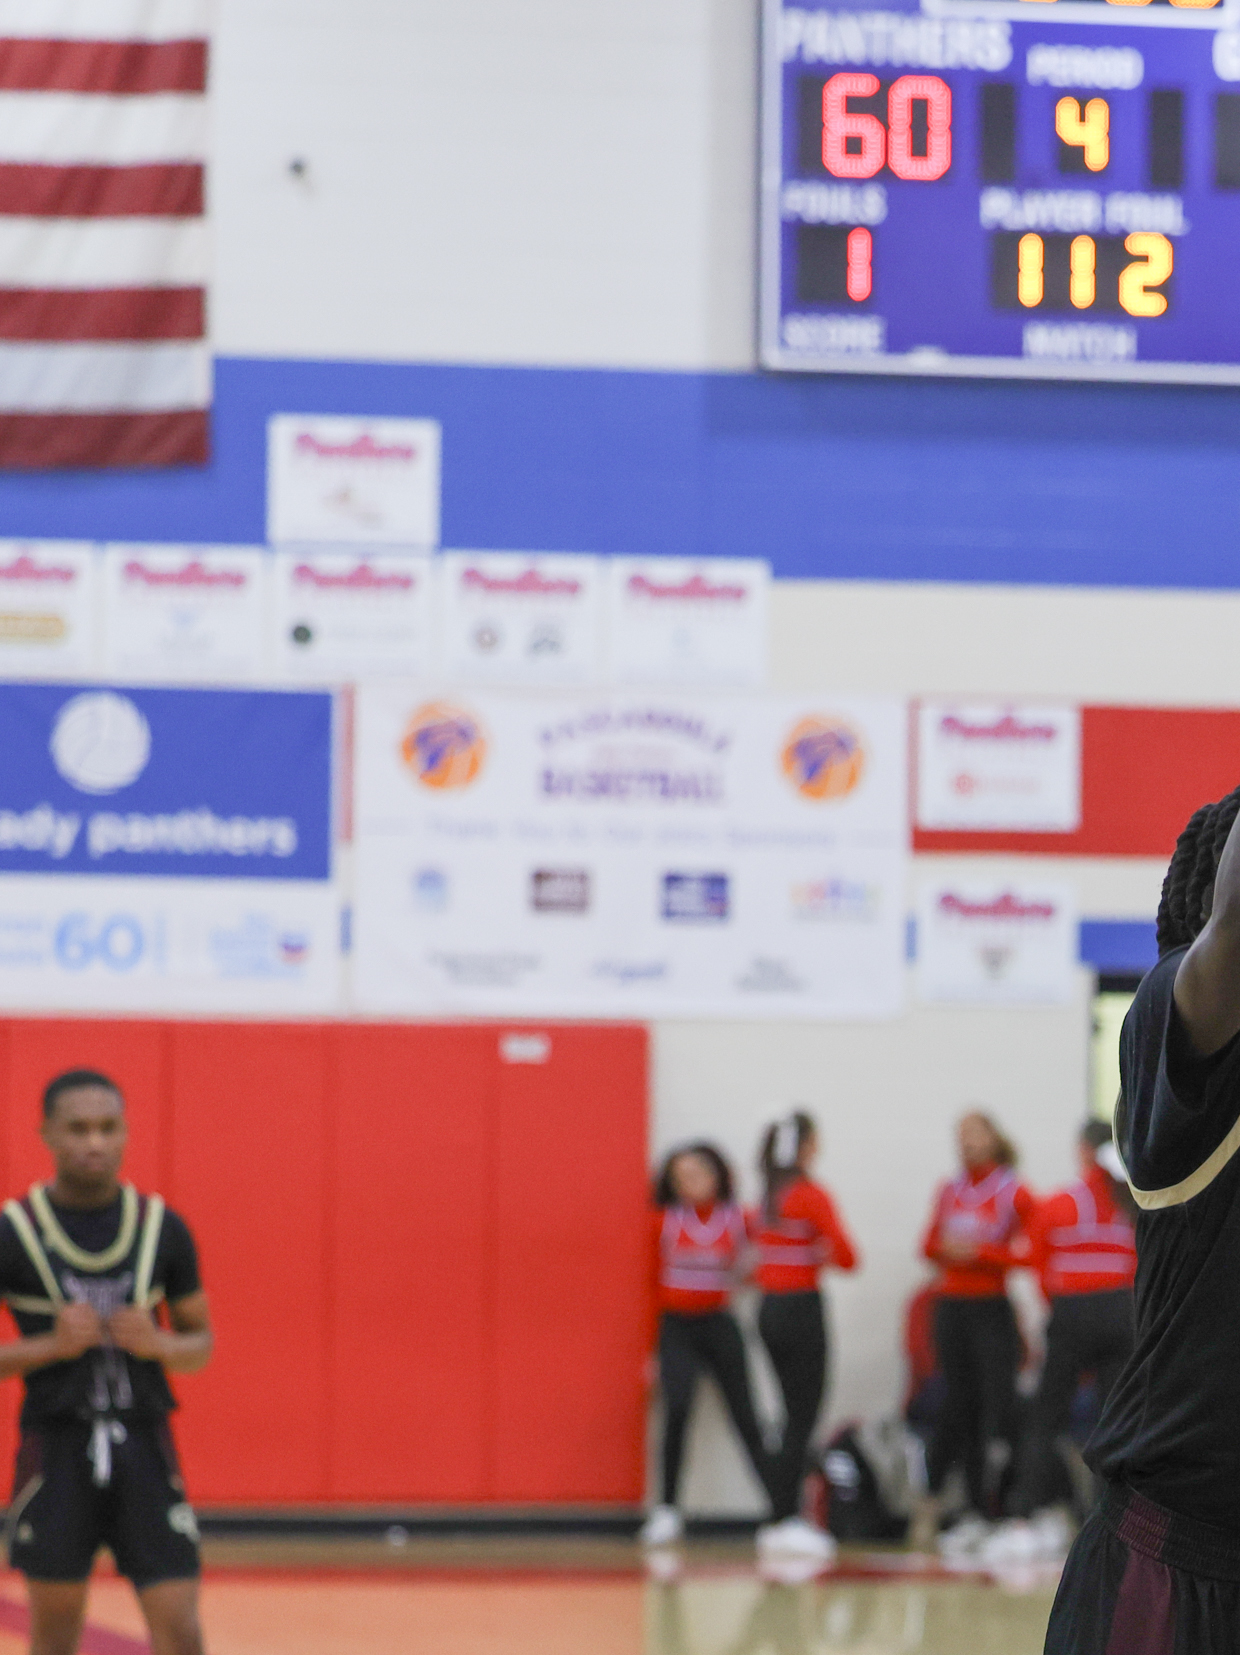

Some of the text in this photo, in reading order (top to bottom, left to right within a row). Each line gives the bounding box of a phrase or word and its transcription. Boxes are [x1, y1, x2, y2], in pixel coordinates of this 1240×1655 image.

[783, 8, 1013, 72] PANTHERS
[821, 72, 952, 181] 60
[1055, 96, 1110, 171] 4
[846, 227, 873, 302] 1
[87, 808, 298, 860] panthers
[53, 912, 146, 974] 60
